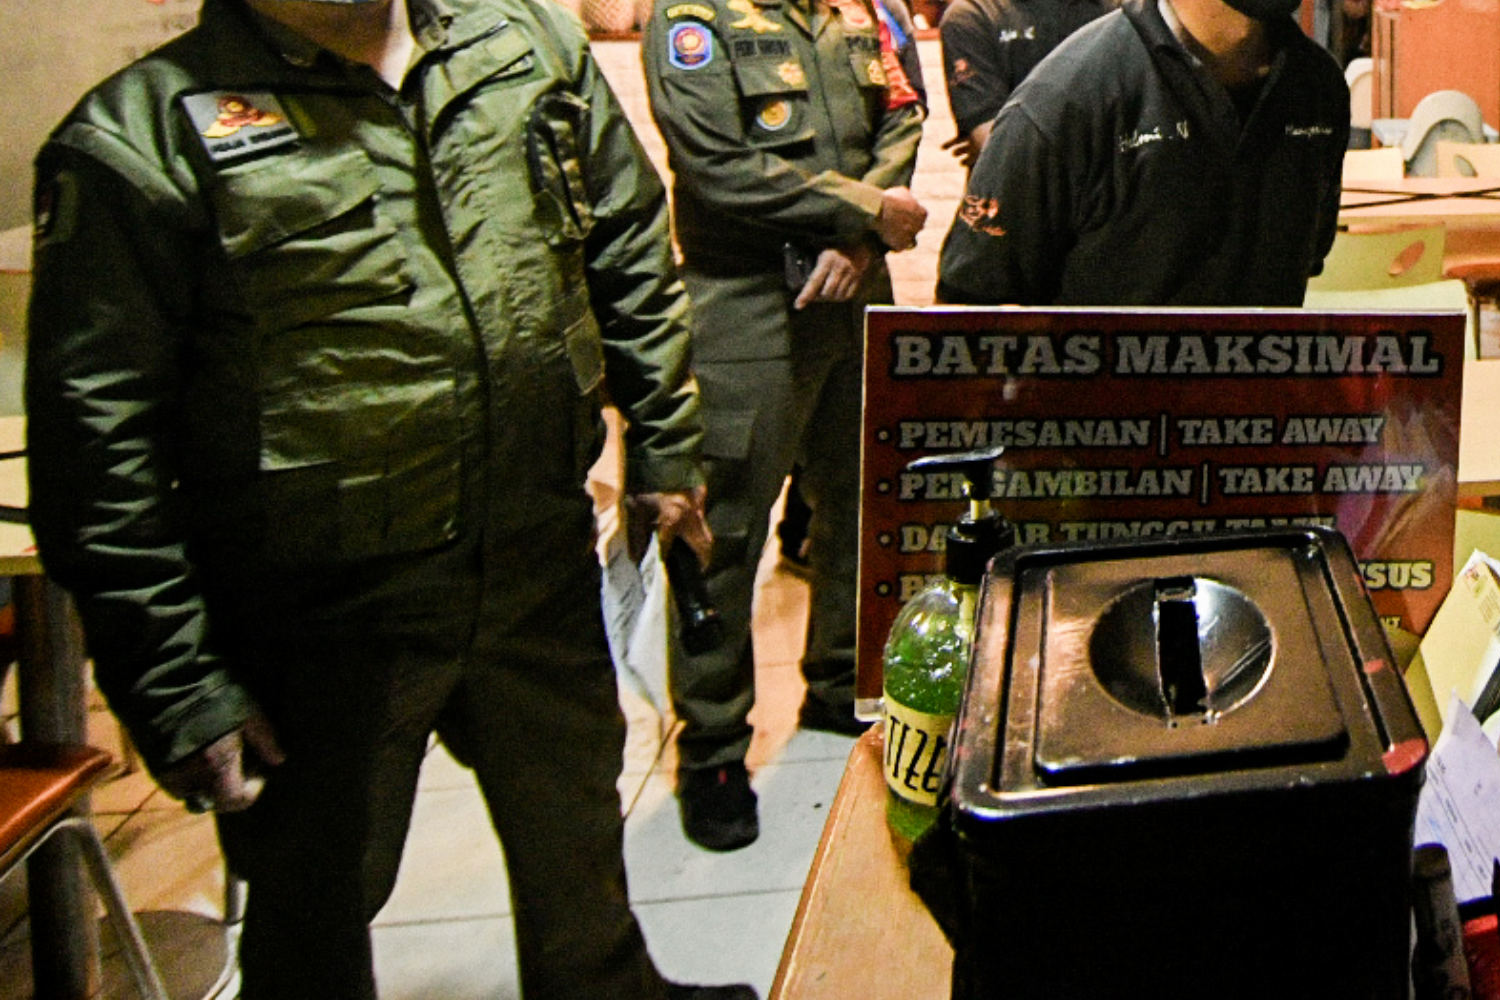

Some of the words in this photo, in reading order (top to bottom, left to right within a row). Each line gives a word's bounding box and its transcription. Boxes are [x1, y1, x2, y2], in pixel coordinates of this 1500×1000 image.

[894, 335, 1100, 376] BATAS
[1115, 335, 1440, 375] MAKSIMAL
[900, 420, 1151, 448] PEMESANAN
[1177, 418, 1274, 445] TAKE
[1281, 417, 1384, 444] AWAY
[1219, 467, 1314, 494] TAKE
[1322, 466, 1424, 494] AWAY
